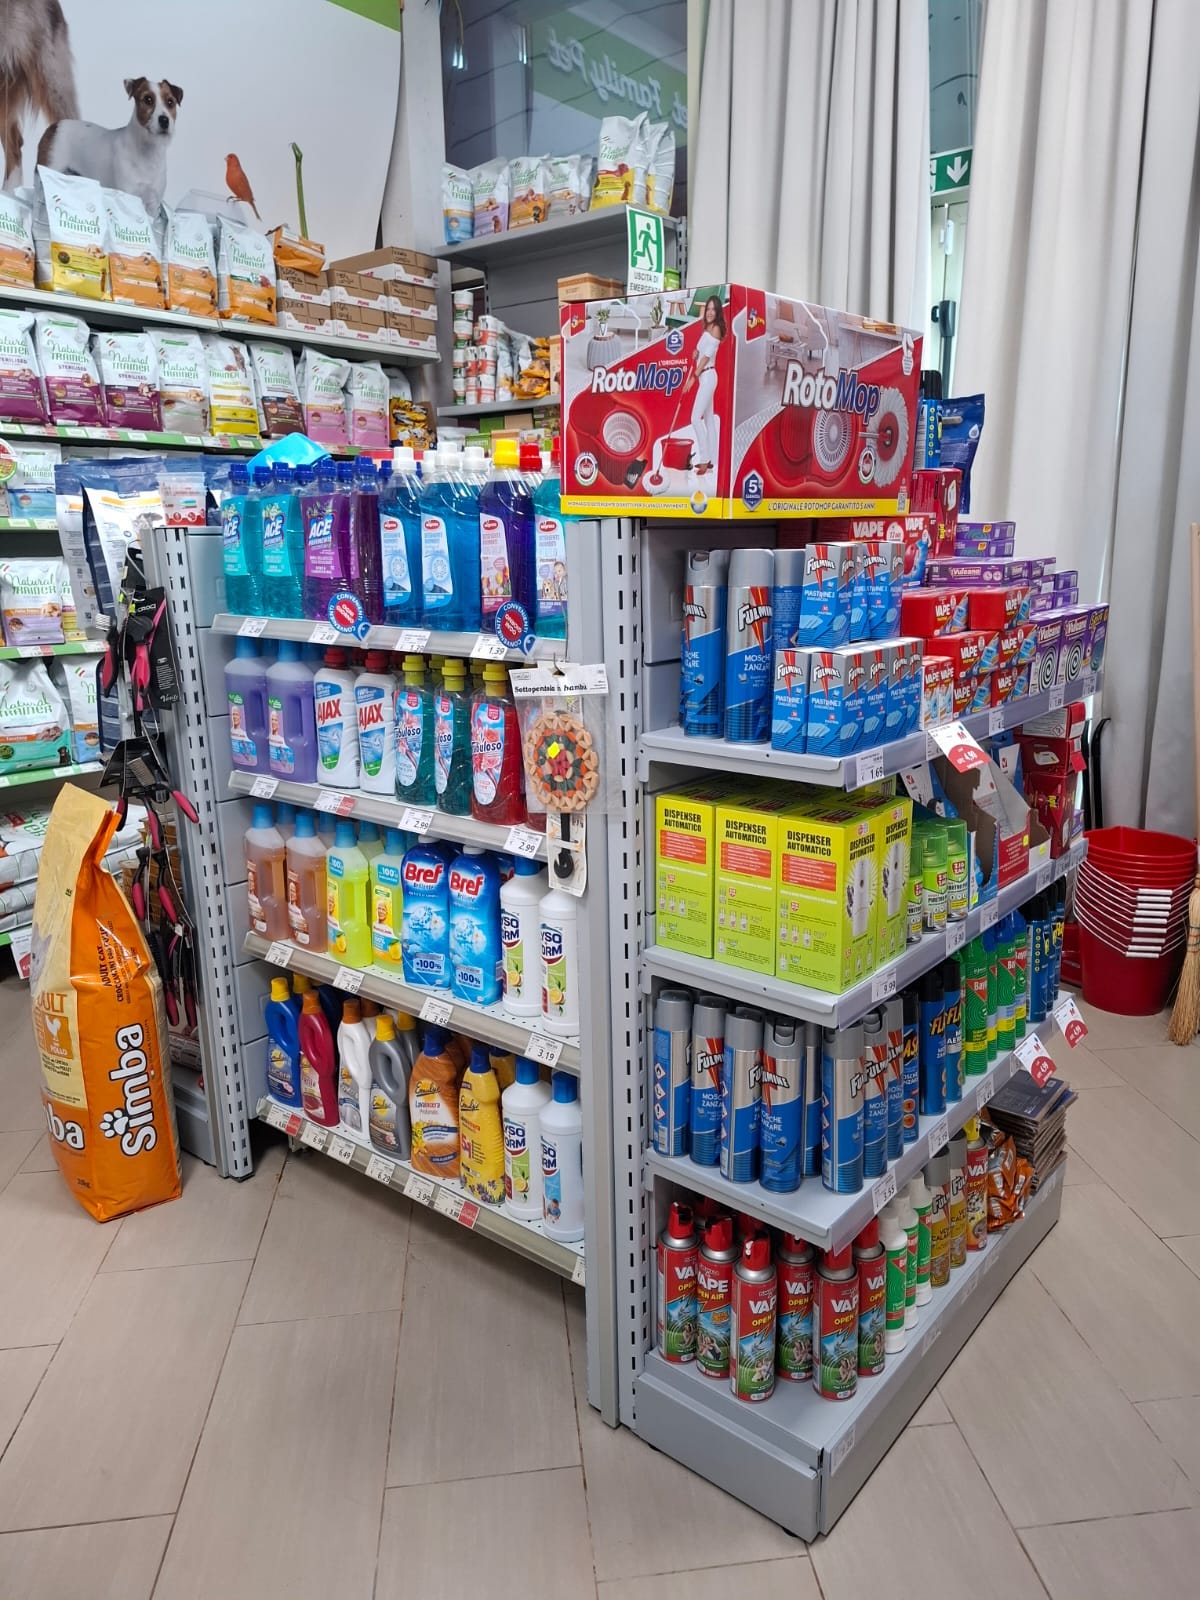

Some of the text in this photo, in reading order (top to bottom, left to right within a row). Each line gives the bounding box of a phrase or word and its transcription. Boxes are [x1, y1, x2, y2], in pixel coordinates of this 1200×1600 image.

[54, 206, 100, 228] Natural
[58, 219, 101, 235] TRAINER
[112, 223, 151, 239] Natural
[47, 339, 87, 356] Natural
[108, 350, 149, 367] Natural
[592, 363, 684, 397] RotoMop
[781, 359, 880, 426] RotoMop
[264, 518, 283, 539] ACE
[309, 519, 332, 539] ACE
[852, 520, 885, 539] VAPE
[905, 517, 925, 531] VAPE
[738, 603, 773, 632] FULMIN
[935, 603, 951, 617] VAPE
[1001, 636, 1018, 651] VAPE
[960, 645, 978, 660] VAPE
[953, 686, 971, 700] VAPE
[317, 698, 342, 726] AJAX
[359, 703, 384, 730] AJAX
[664, 808, 702, 823] DISPENSER
[664, 819, 702, 833] AUTOMATICO
[725, 819, 767, 836] DISPENSER
[725, 831, 767, 845] AUTOMATICO
[787, 830, 832, 847] DISPENSER
[787, 841, 832, 857] AUTOMATICO
[405, 861, 444, 884] Bref
[449, 871, 484, 897] Bref
[541, 931, 562, 944] YSO
[541, 944, 563, 956] ORM
[108, 1022, 158, 1157] simba
[504, 1123, 526, 1139] YSO
[504, 1137, 527, 1150] ORM
[697, 1271, 728, 1293] APE
[786, 1280, 813, 1295] VAP
[748, 1295, 777, 1314] VAP
[788, 1298, 809, 1306] OPEN
[831, 1296, 859, 1313] VAP
[752, 1315, 772, 1327] OPEN
[834, 1315, 855, 1326] OPEN
